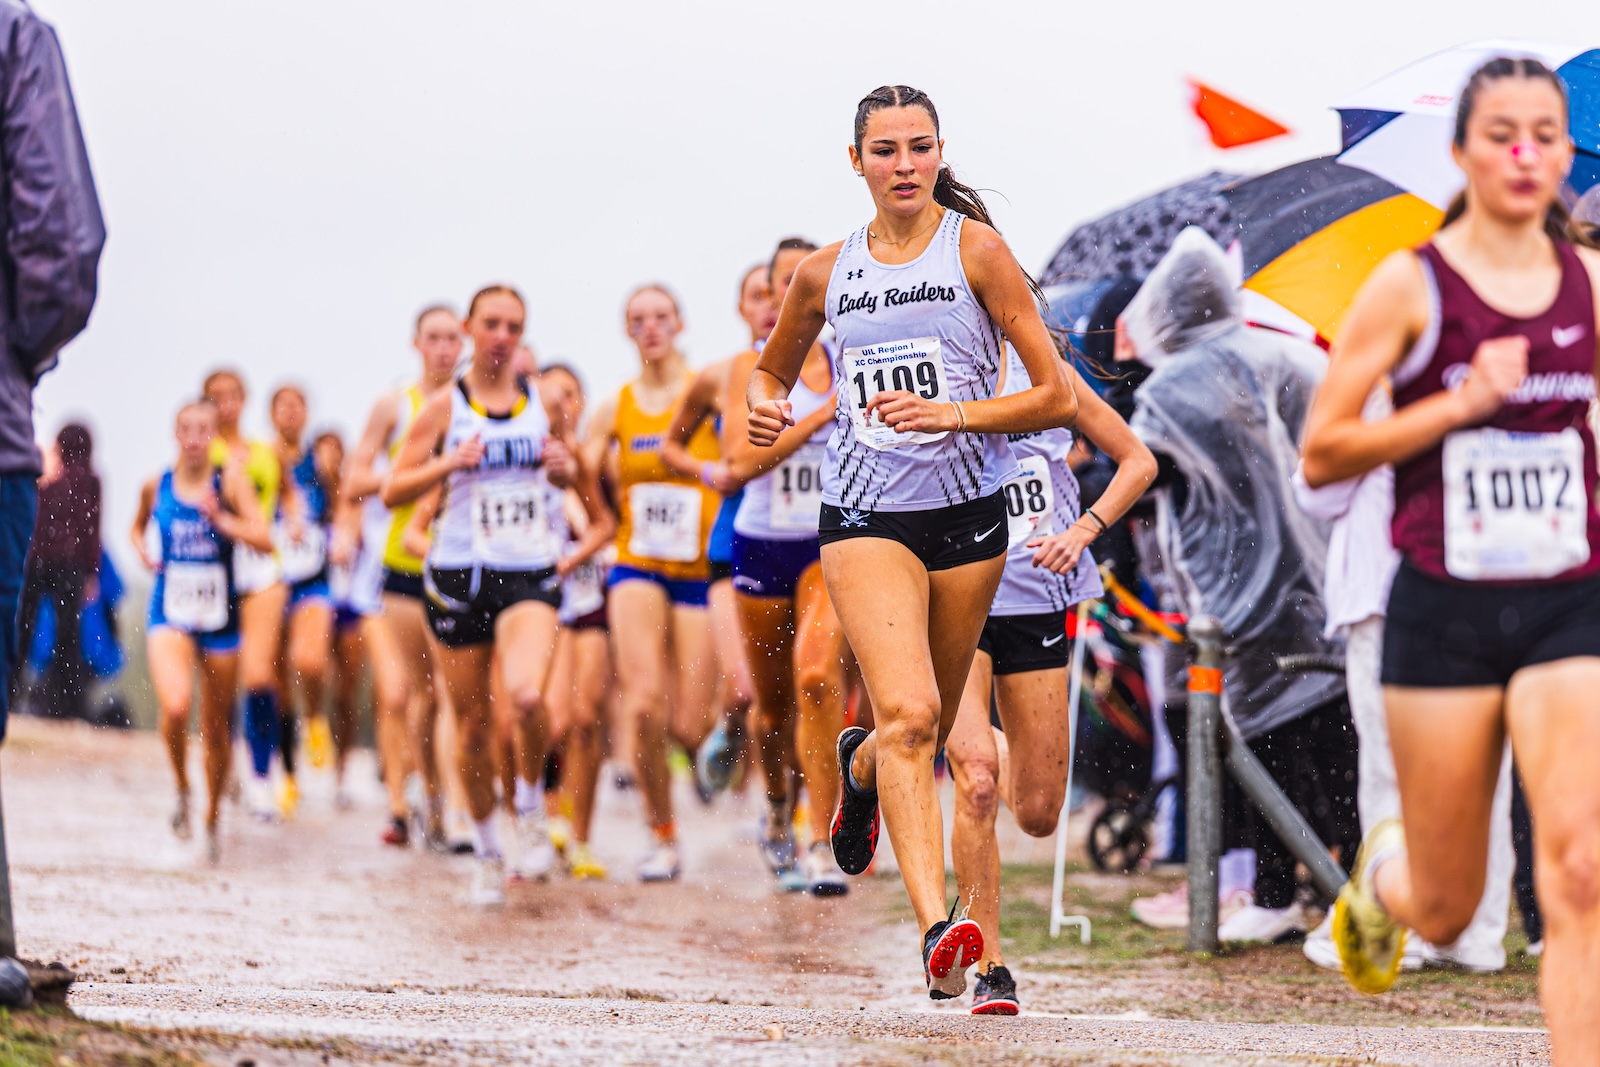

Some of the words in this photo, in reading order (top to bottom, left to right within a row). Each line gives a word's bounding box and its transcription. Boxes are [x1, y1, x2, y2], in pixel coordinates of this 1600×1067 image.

[837, 291, 878, 316] Lady
[884, 281, 955, 307] Raiders
[855, 359, 866, 367] XC
[867, 351, 927, 365] Championship
[862, 348, 876, 356] UIL
[877, 343, 908, 355] Region
[853, 361, 939, 409] 1109
[1004, 479, 1046, 517] 08
[1465, 463, 1572, 511] 1002
